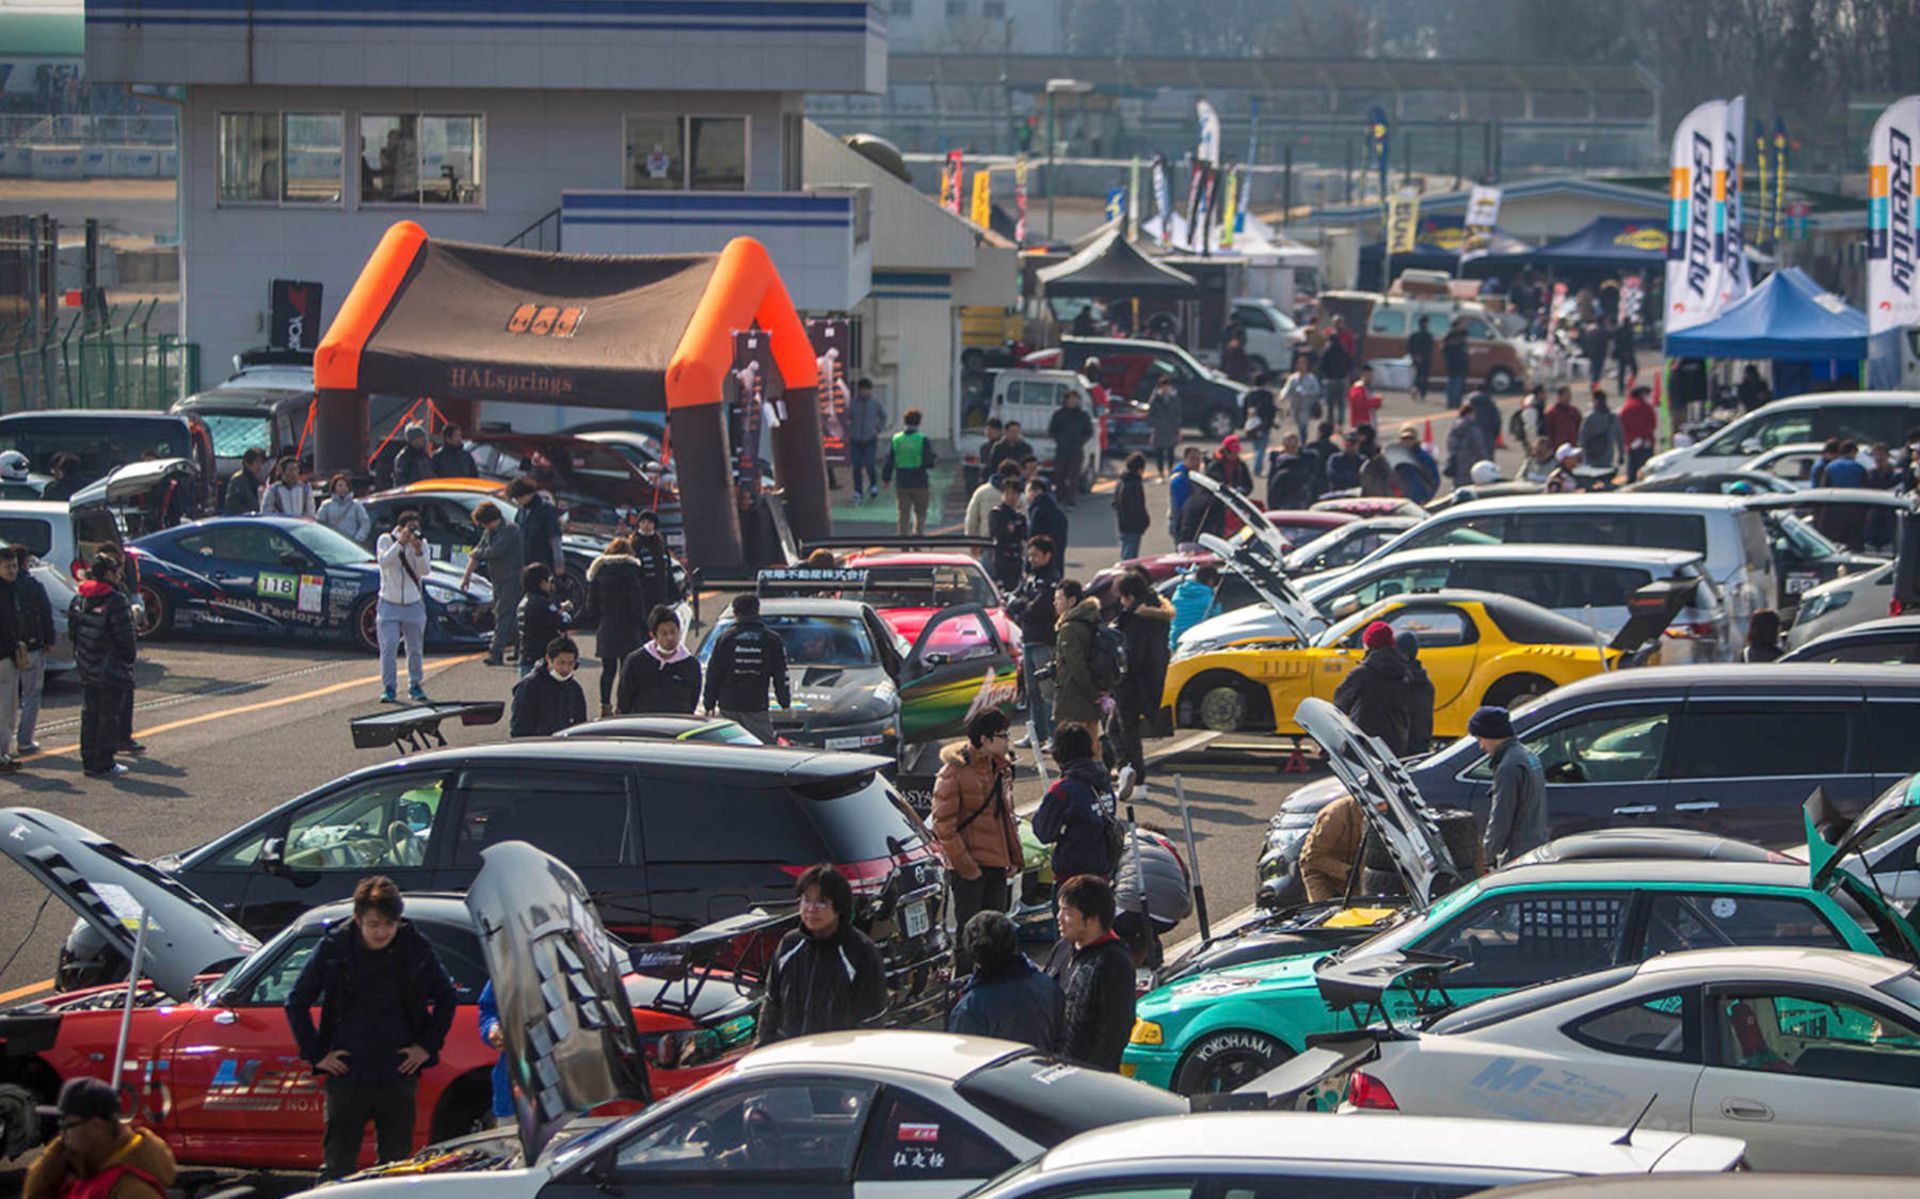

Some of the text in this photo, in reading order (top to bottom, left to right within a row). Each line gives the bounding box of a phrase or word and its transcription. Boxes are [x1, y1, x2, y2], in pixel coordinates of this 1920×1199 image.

[451, 367, 573, 394] HALsprings
[262, 577, 293, 593] 118
[261, 602, 325, 627] Factory
[1197, 1035, 1274, 1061] YOKOHAMA
